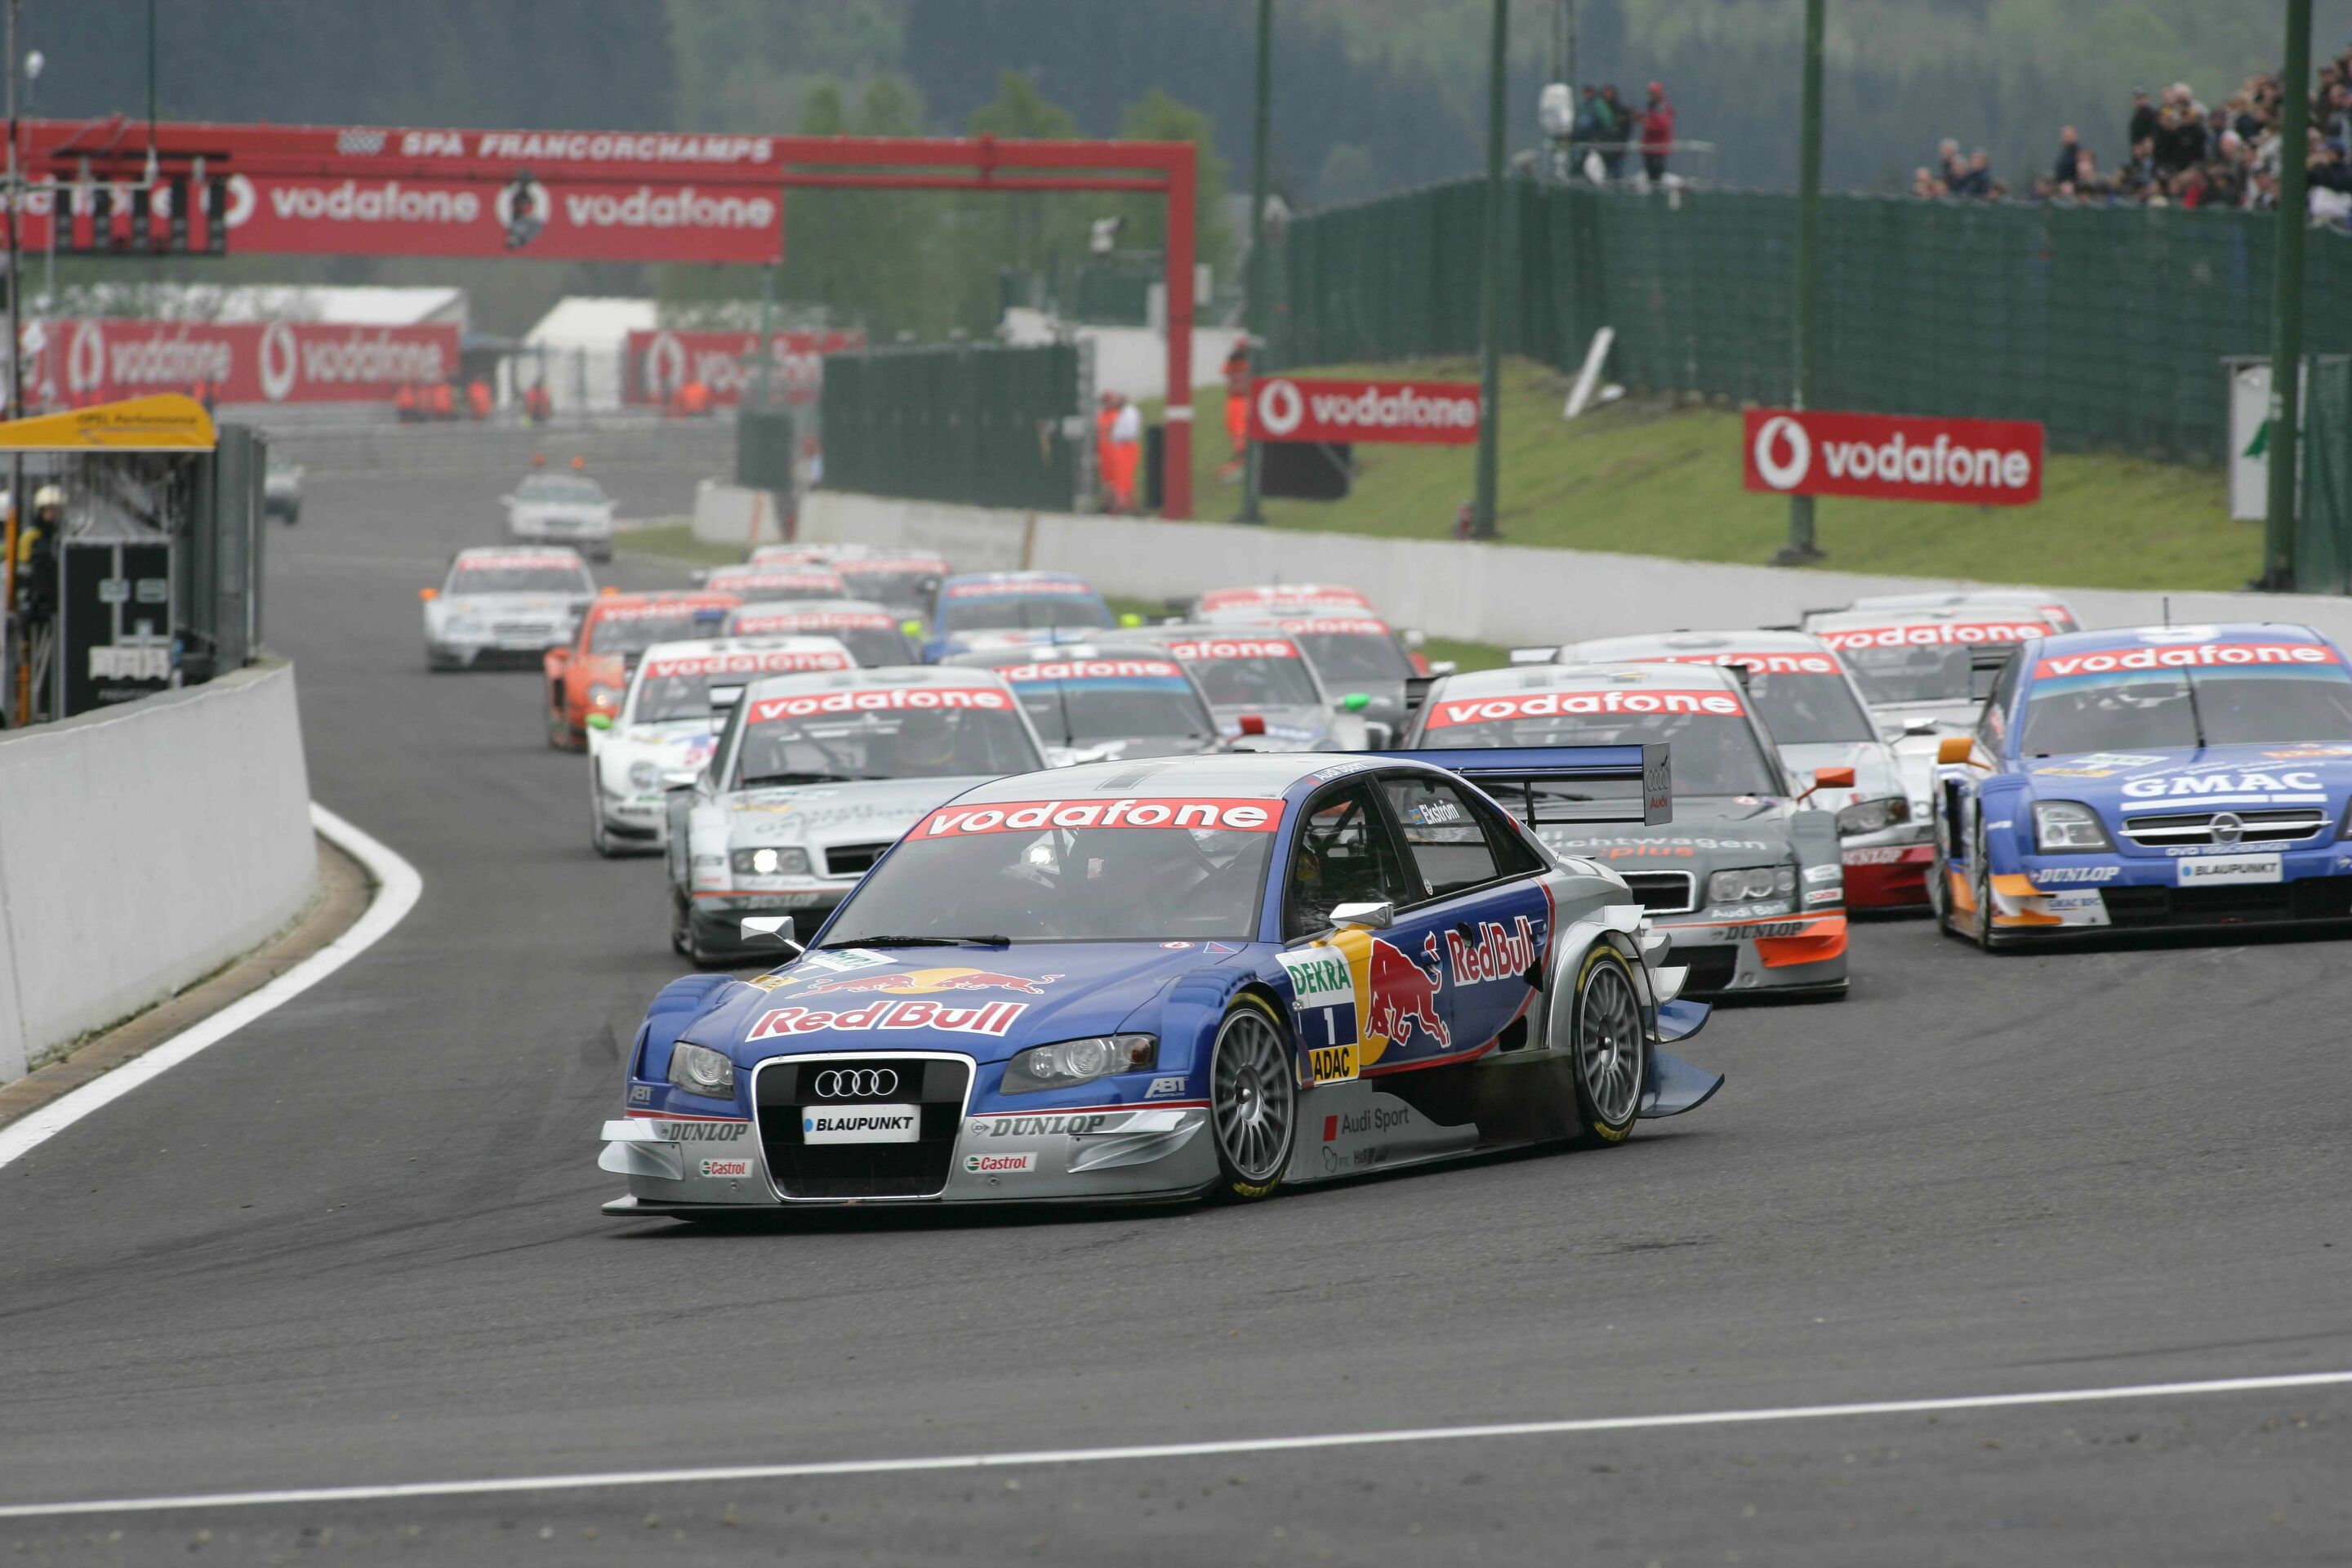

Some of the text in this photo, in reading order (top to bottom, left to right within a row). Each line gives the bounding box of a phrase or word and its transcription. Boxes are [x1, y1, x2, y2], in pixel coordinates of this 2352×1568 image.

[402, 133, 773, 162] SPA FRANCORCHAMPS
[271, 179, 479, 222] vodafone
[566, 186, 775, 228] vodafone
[1312, 386, 1476, 428] vodafone
[1823, 432, 2030, 488] vodafone
[657, 653, 840, 677] vodafone
[2047, 643, 2327, 676] vodafone
[758, 688, 1003, 719] vodafone
[1447, 692, 1738, 723] vodafone
[2121, 772, 2323, 797] GMAC
[1419, 800, 1460, 825] Ekström
[1650, 796, 1668, 809] Audi
[928, 800, 1268, 836] vodafone
[2038, 866, 2122, 883] DUNLOP
[2194, 862, 2278, 876] BLAUPUNKT
[1712, 904, 1752, 919] Audi
[1724, 922, 1802, 941] DUNLOP
[1287, 958, 1352, 996] DEKRA
[1324, 1007, 1336, 1045] 1
[1314, 1047, 1350, 1081] ADAC
[630, 1085, 654, 1103] ABT
[1145, 1076, 1189, 1098] ABT
[670, 1123, 748, 1142] DUNLOP
[817, 1116, 914, 1132] BLAUPUNKT
[990, 1115, 1107, 1137] DUNLOP
[1342, 1106, 1410, 1135] Audi Sport
[711, 1161, 746, 1175] Castrol
[982, 1156, 1027, 1170] Castrol
